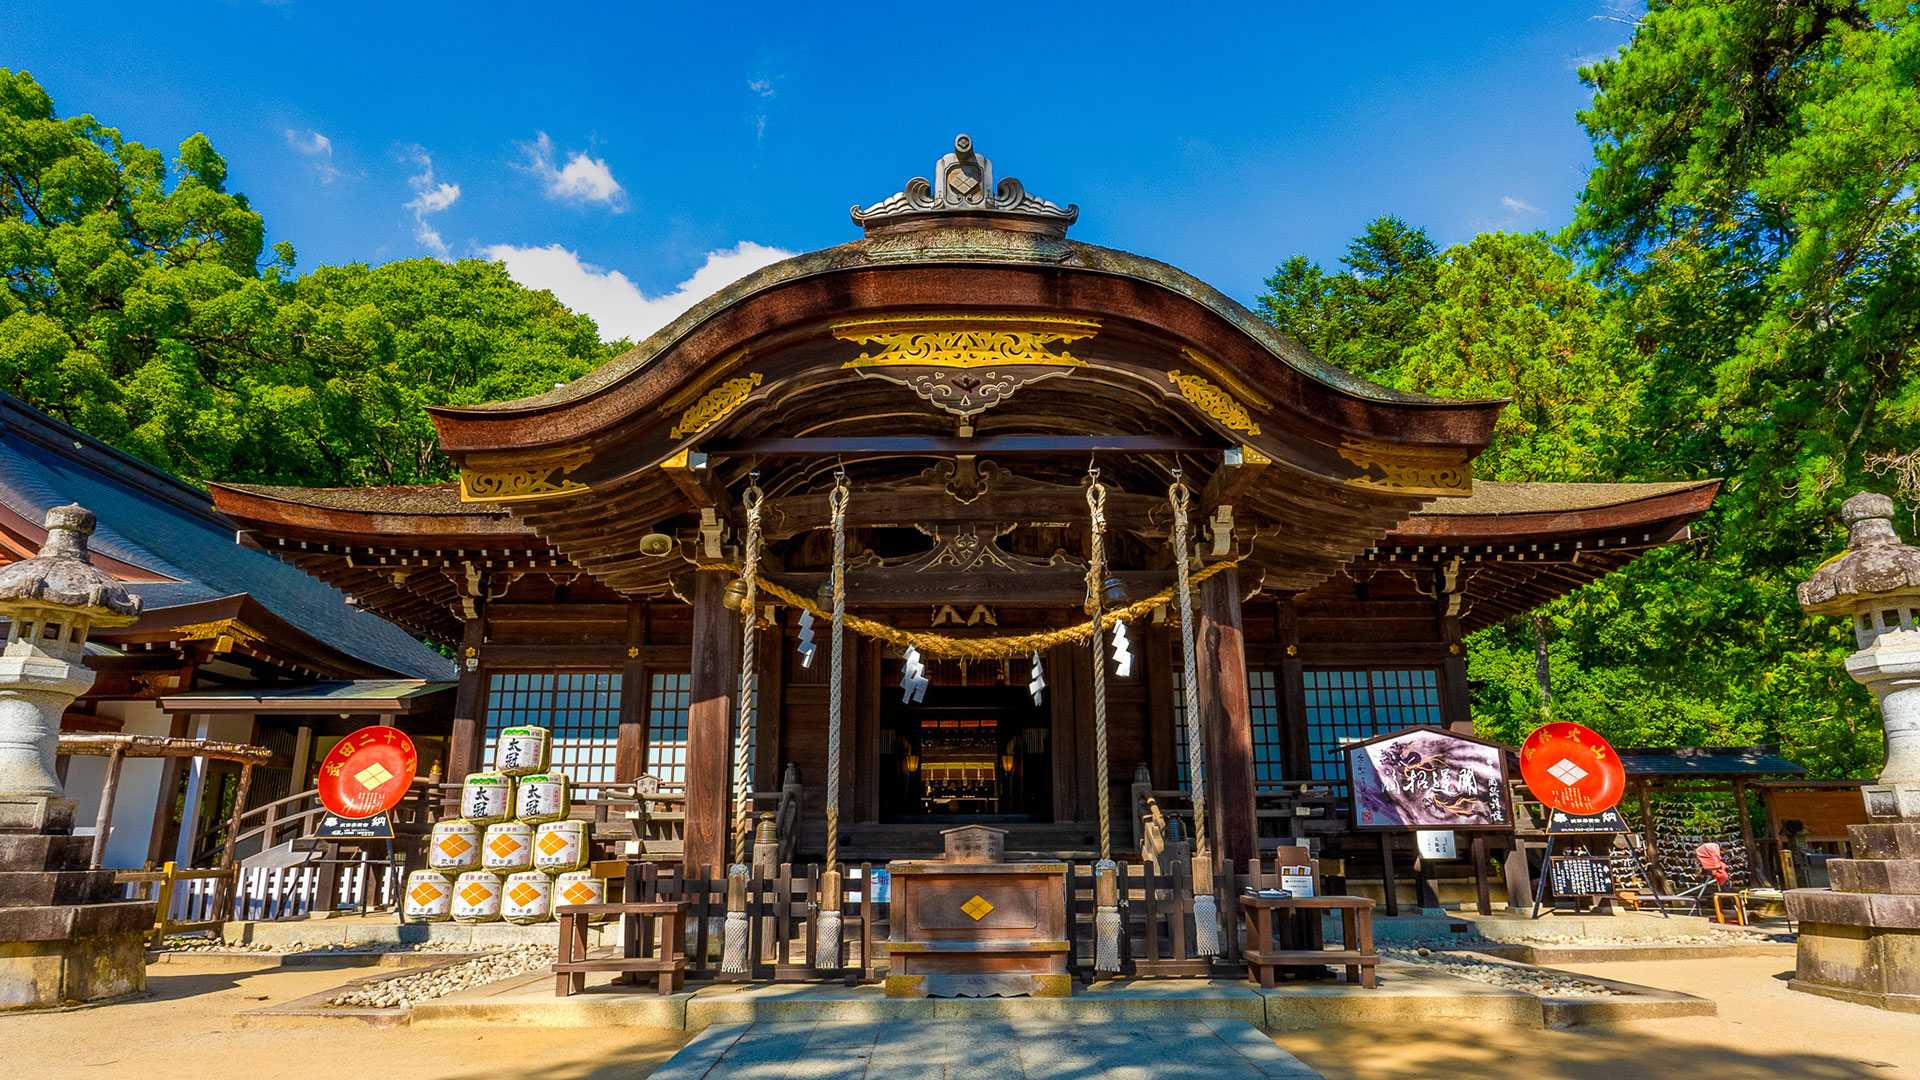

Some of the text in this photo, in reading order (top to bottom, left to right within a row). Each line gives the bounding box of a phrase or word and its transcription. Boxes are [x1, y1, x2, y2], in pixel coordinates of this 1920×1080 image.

[505, 738, 522, 768] 太冠
[1524, 727, 1606, 760] 風林火山
[473, 786, 490, 817] 太冠
[525, 784, 541, 816] 太冠
